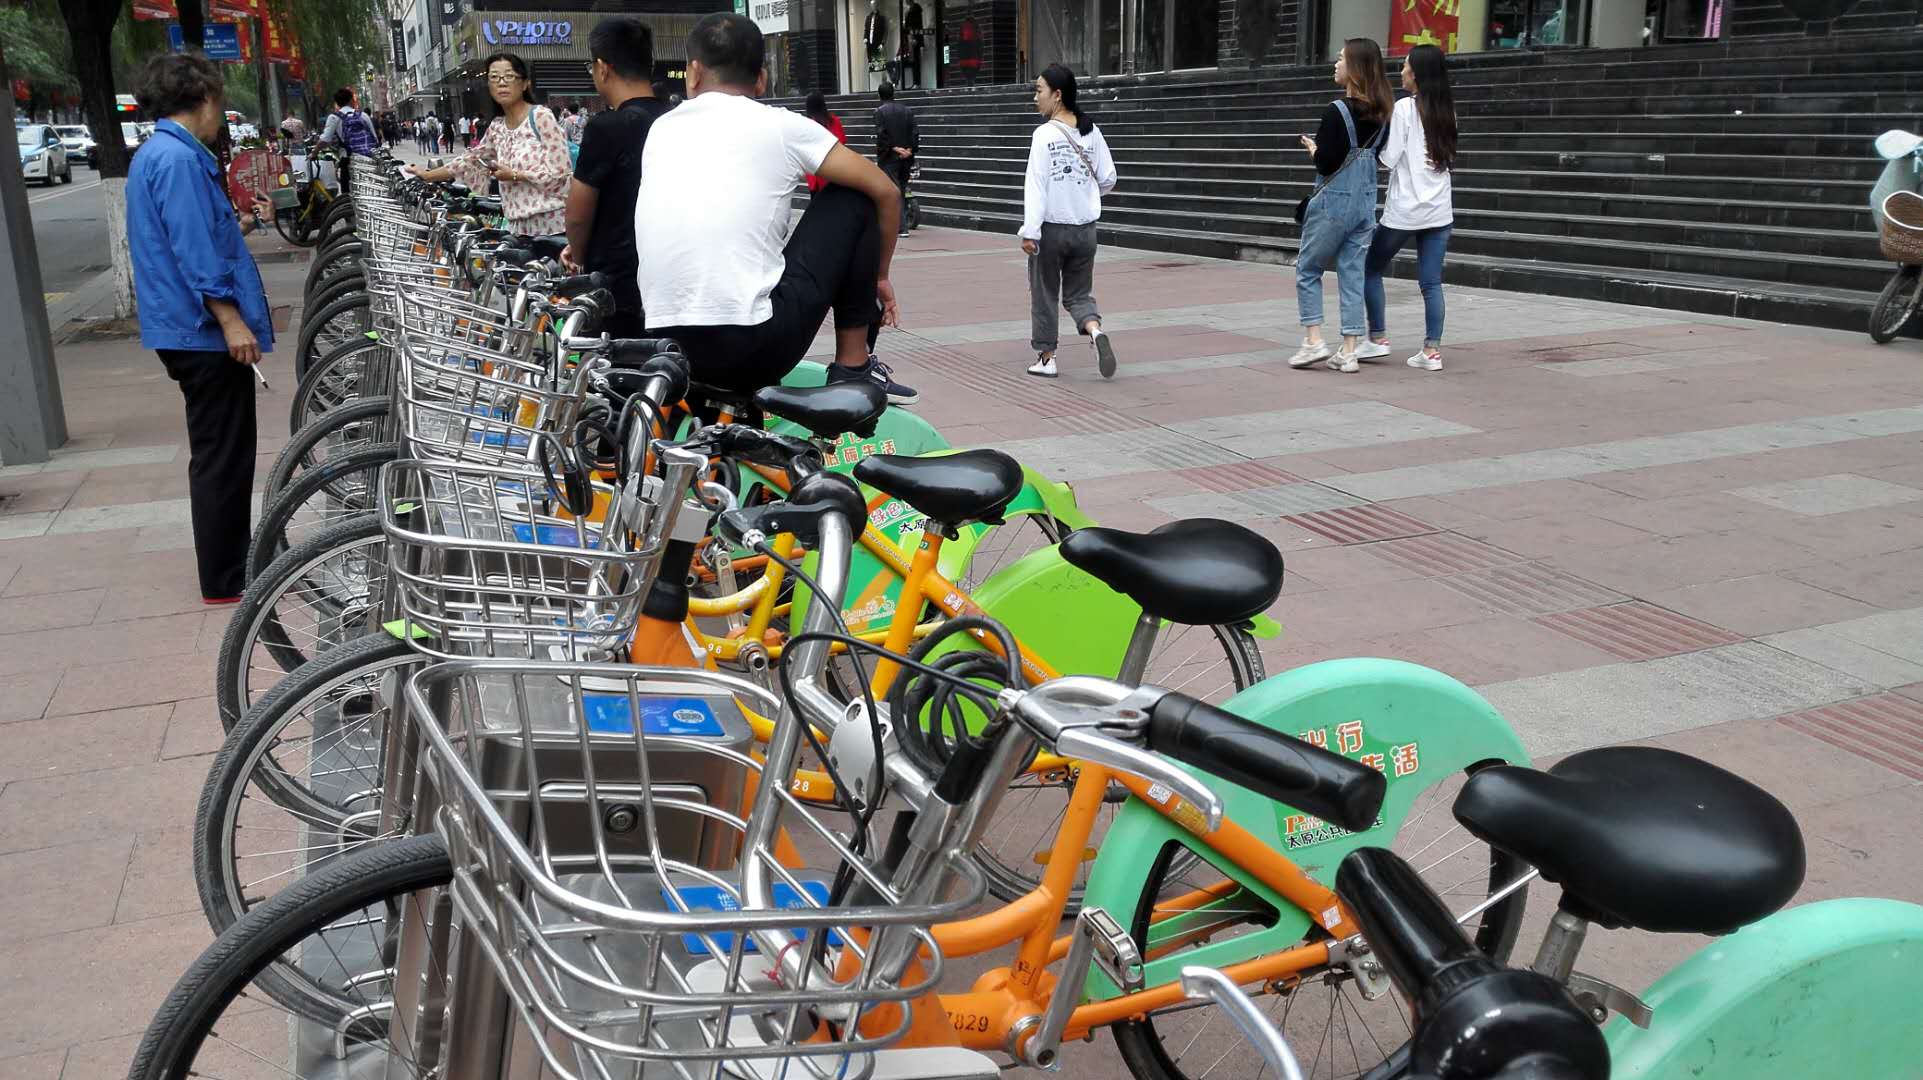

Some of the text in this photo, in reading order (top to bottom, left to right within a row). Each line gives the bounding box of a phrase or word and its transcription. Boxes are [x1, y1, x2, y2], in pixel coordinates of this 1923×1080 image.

[708, 642, 722, 654] 96
[1299, 719, 1364, 754] 出行
[792, 778, 810, 792] 28
